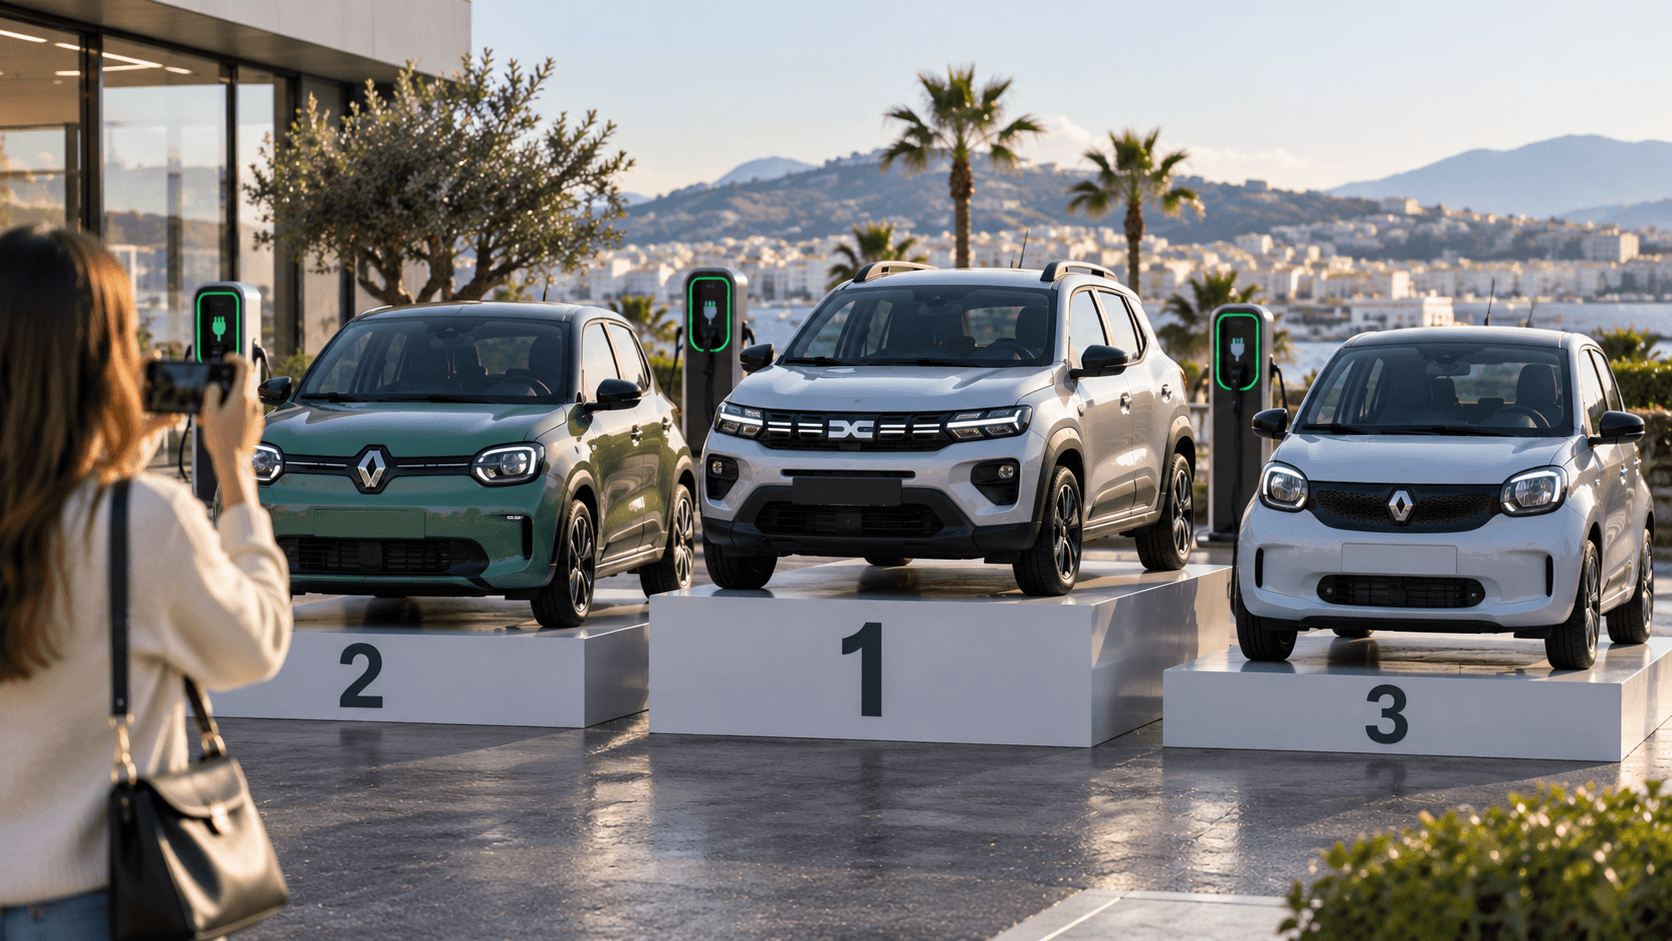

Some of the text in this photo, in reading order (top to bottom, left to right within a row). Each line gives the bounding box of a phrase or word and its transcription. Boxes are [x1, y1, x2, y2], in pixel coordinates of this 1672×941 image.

[339, 643, 383, 708] 2
[842, 622, 882, 717] 1
[1365, 684, 1409, 744] 3
